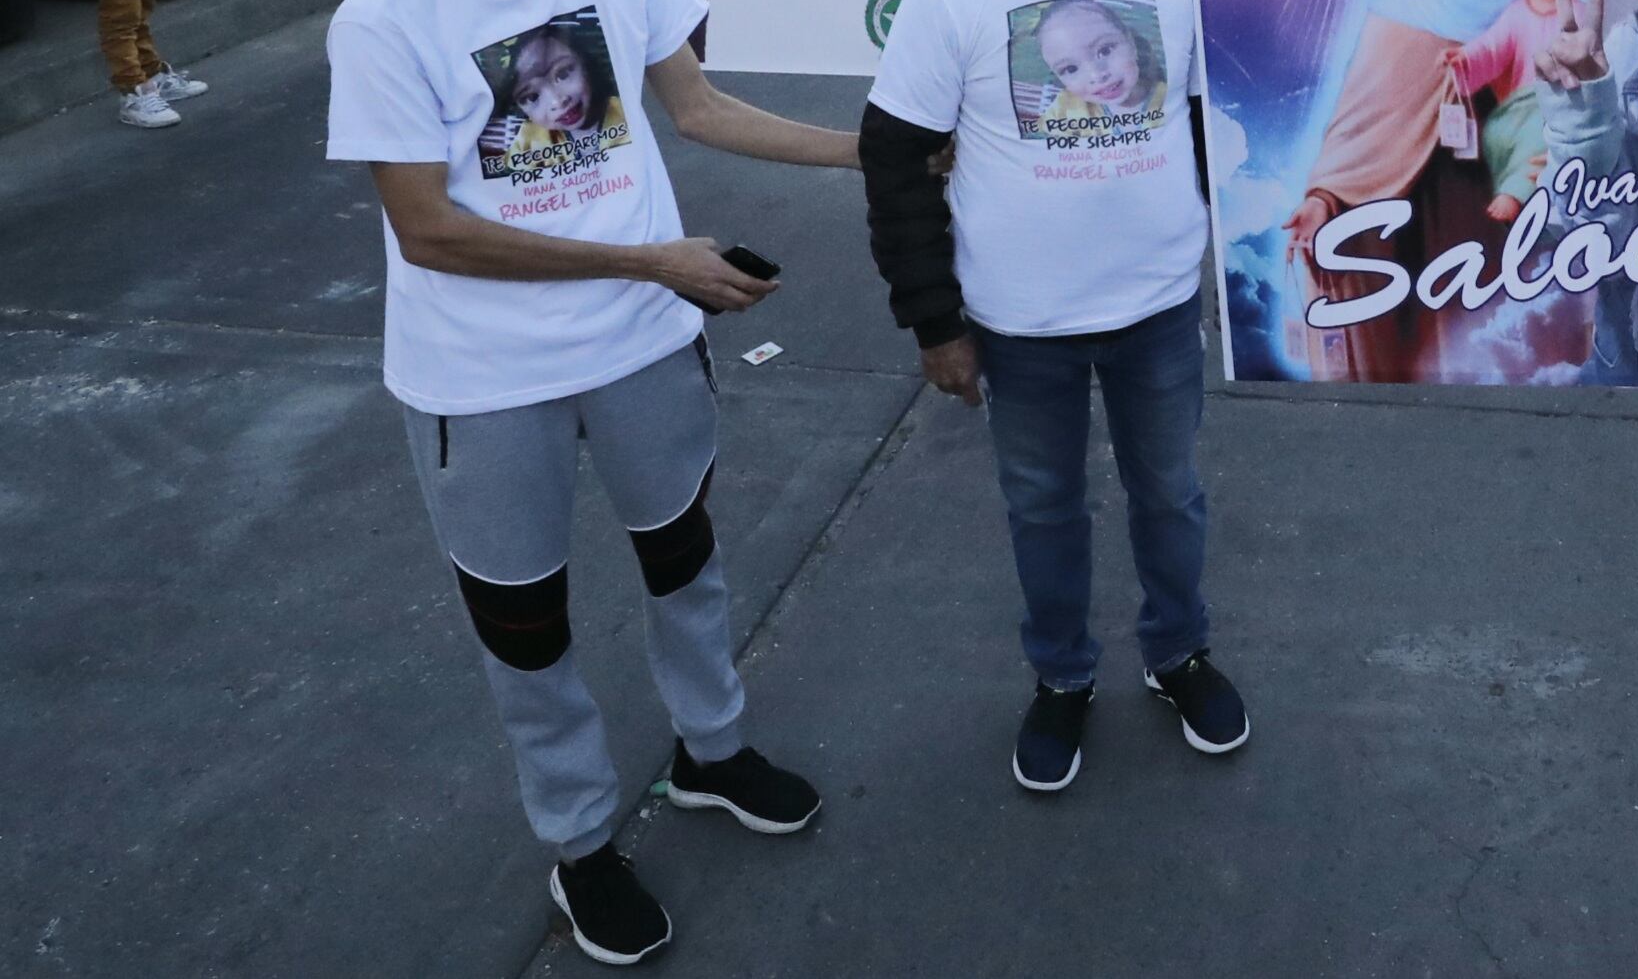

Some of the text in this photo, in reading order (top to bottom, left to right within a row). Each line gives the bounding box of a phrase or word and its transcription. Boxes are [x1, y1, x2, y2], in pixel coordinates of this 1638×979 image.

[1020, 107, 1165, 134] TE RECORDAREMOS
[483, 124, 629, 173] TE RECORDAREMOS
[1046, 128, 1152, 150] POR SIEMPRE
[511, 148, 610, 187] POR SIEMPRE
[1033, 153, 1168, 180] RANGEL MOLINA
[500, 174, 635, 221] RANGEL MOLINA
[523, 182, 556, 197] IVANA
